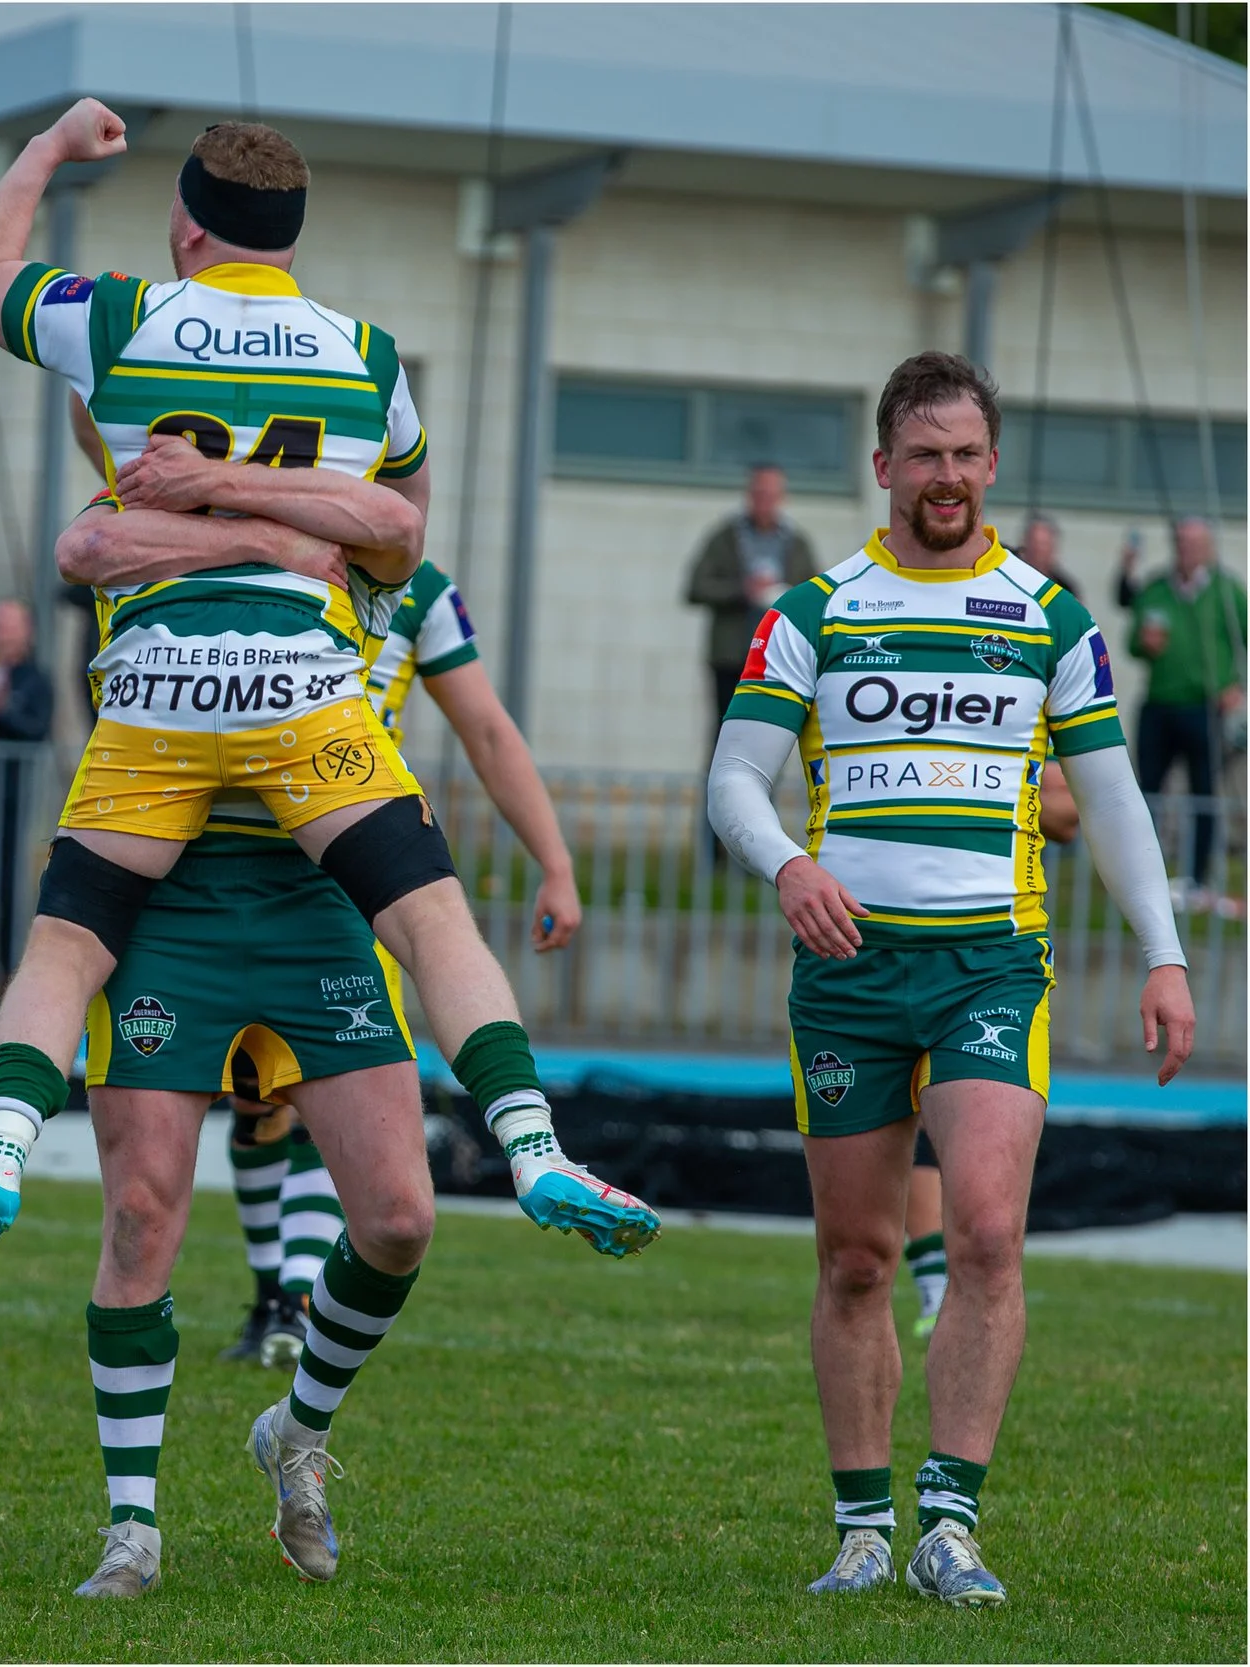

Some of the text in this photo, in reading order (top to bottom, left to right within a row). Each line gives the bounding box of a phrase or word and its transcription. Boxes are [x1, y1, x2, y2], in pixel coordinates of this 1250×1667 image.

[173, 317, 319, 361] Qualis
[970, 601, 1022, 614] LEAPFROG
[134, 647, 203, 665] LITTLE
[207, 648, 239, 666] BIG
[843, 655, 902, 664] GILBERT
[104, 673, 295, 712] BOTTOMS
[845, 676, 1018, 735] Ogier
[847, 761, 1002, 791] PRAXIS
[320, 974, 374, 993] fletcher
[323, 987, 379, 1001] sports
[133, 1009, 161, 1017] GUERNSEY
[124, 1020, 171, 1036] RAIDERS
[335, 1028, 394, 1042] GILBERT
[961, 1045, 1018, 1063] GILBERT
[810, 1071, 851, 1090] RAIDERS
